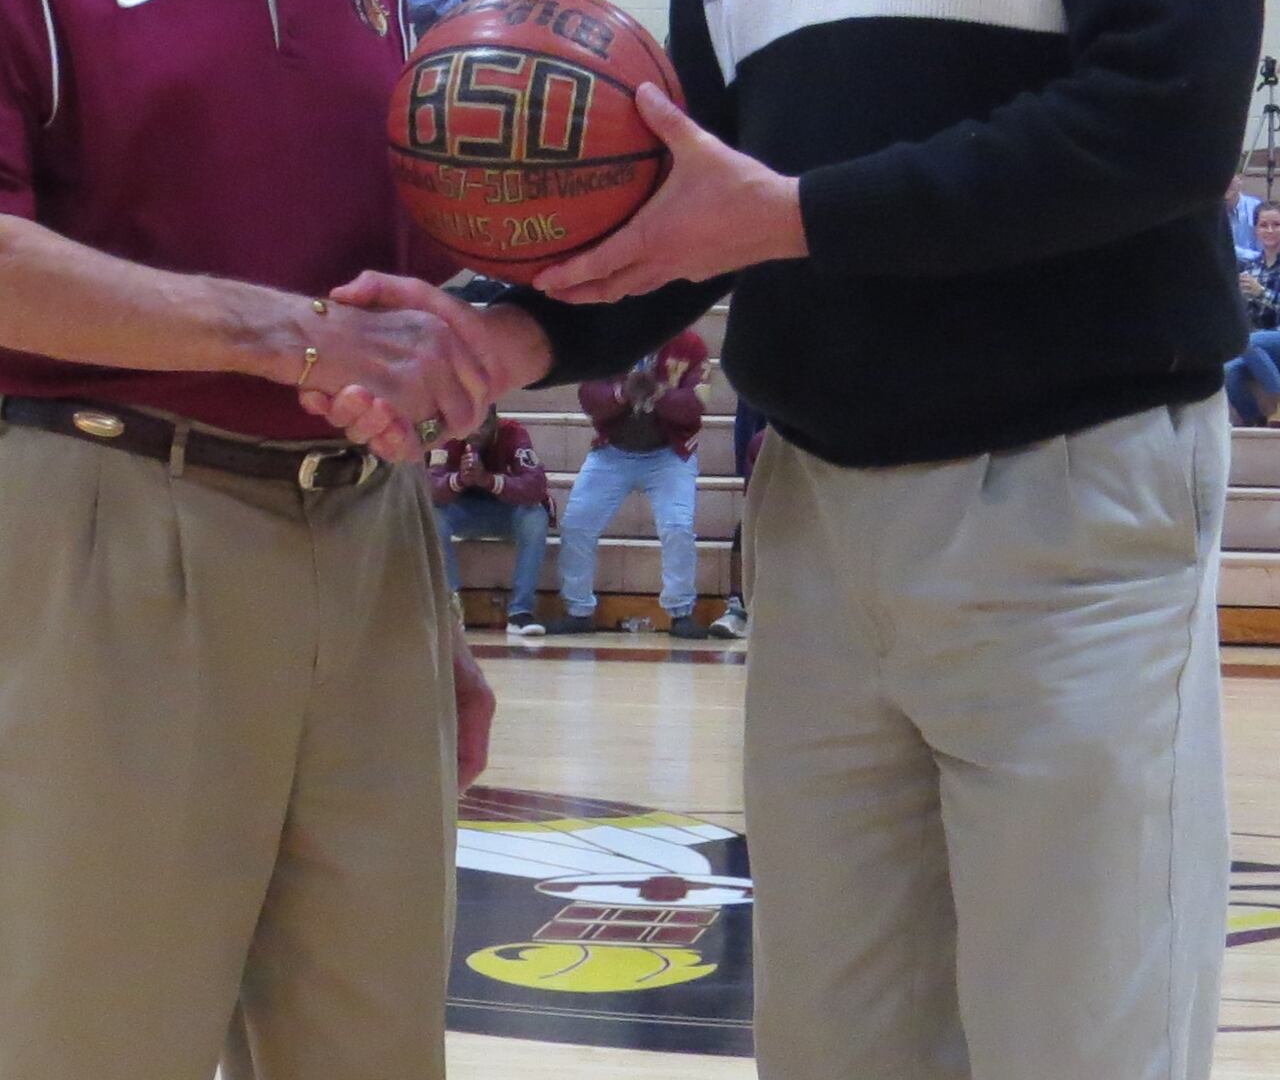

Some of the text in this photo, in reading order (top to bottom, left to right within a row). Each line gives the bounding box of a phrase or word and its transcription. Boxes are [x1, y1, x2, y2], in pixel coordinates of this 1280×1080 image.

[408, 51, 594, 161] 850
[438, 164, 523, 204] 57-50
[504, 211, 566, 247] 2016
